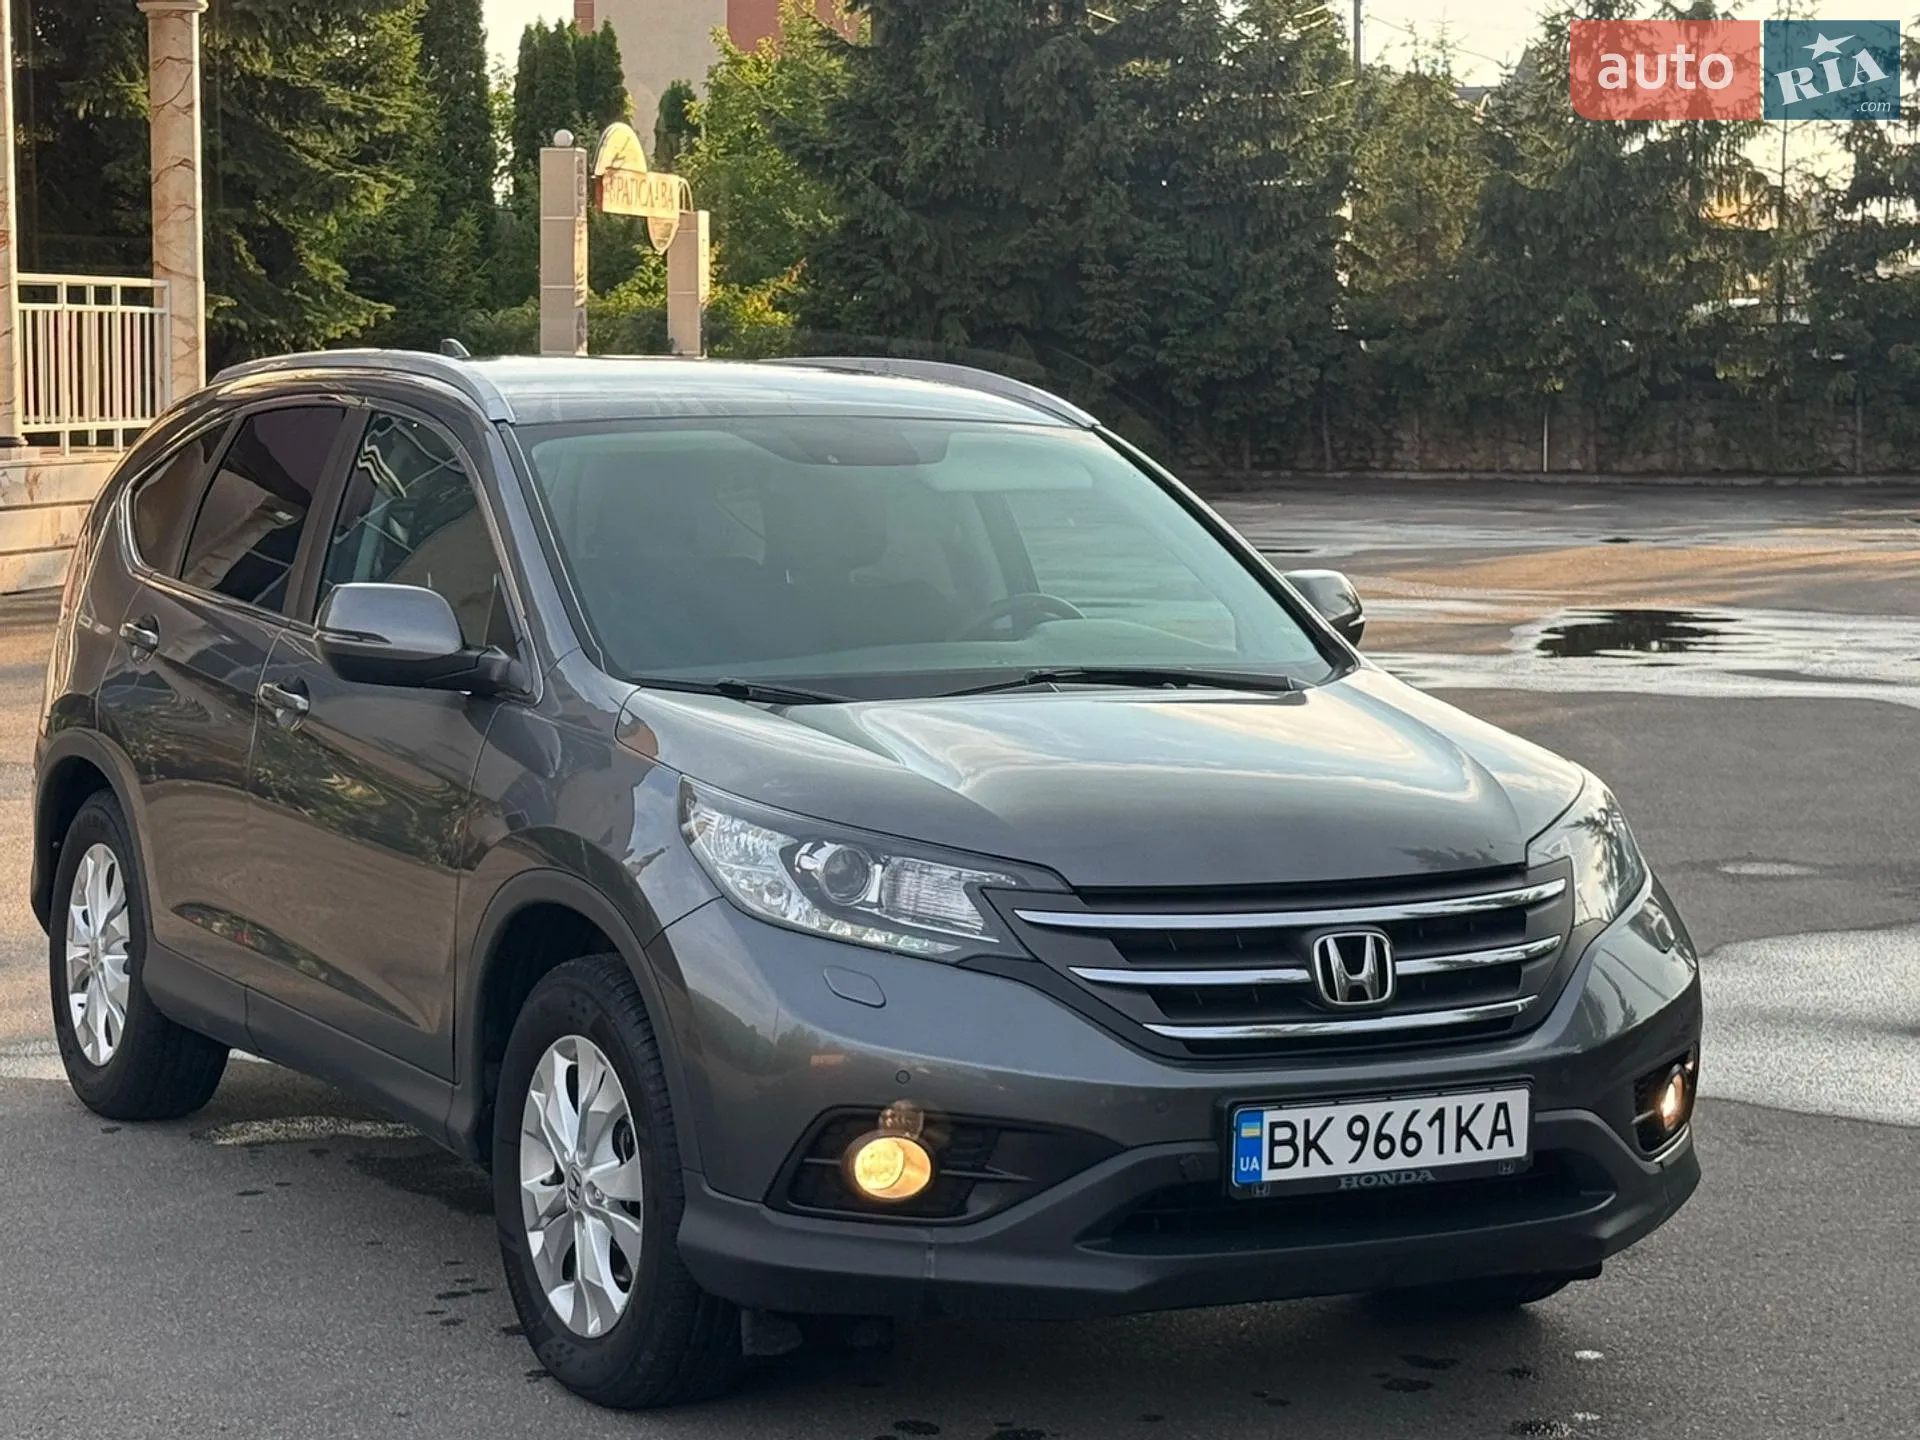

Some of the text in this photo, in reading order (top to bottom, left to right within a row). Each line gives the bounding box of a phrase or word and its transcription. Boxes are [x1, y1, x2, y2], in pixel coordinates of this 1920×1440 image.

[1267, 1116, 1335, 1170] BK
[1239, 1156, 1260, 1172] UA
[1338, 1169, 1436, 1190] HONDA
